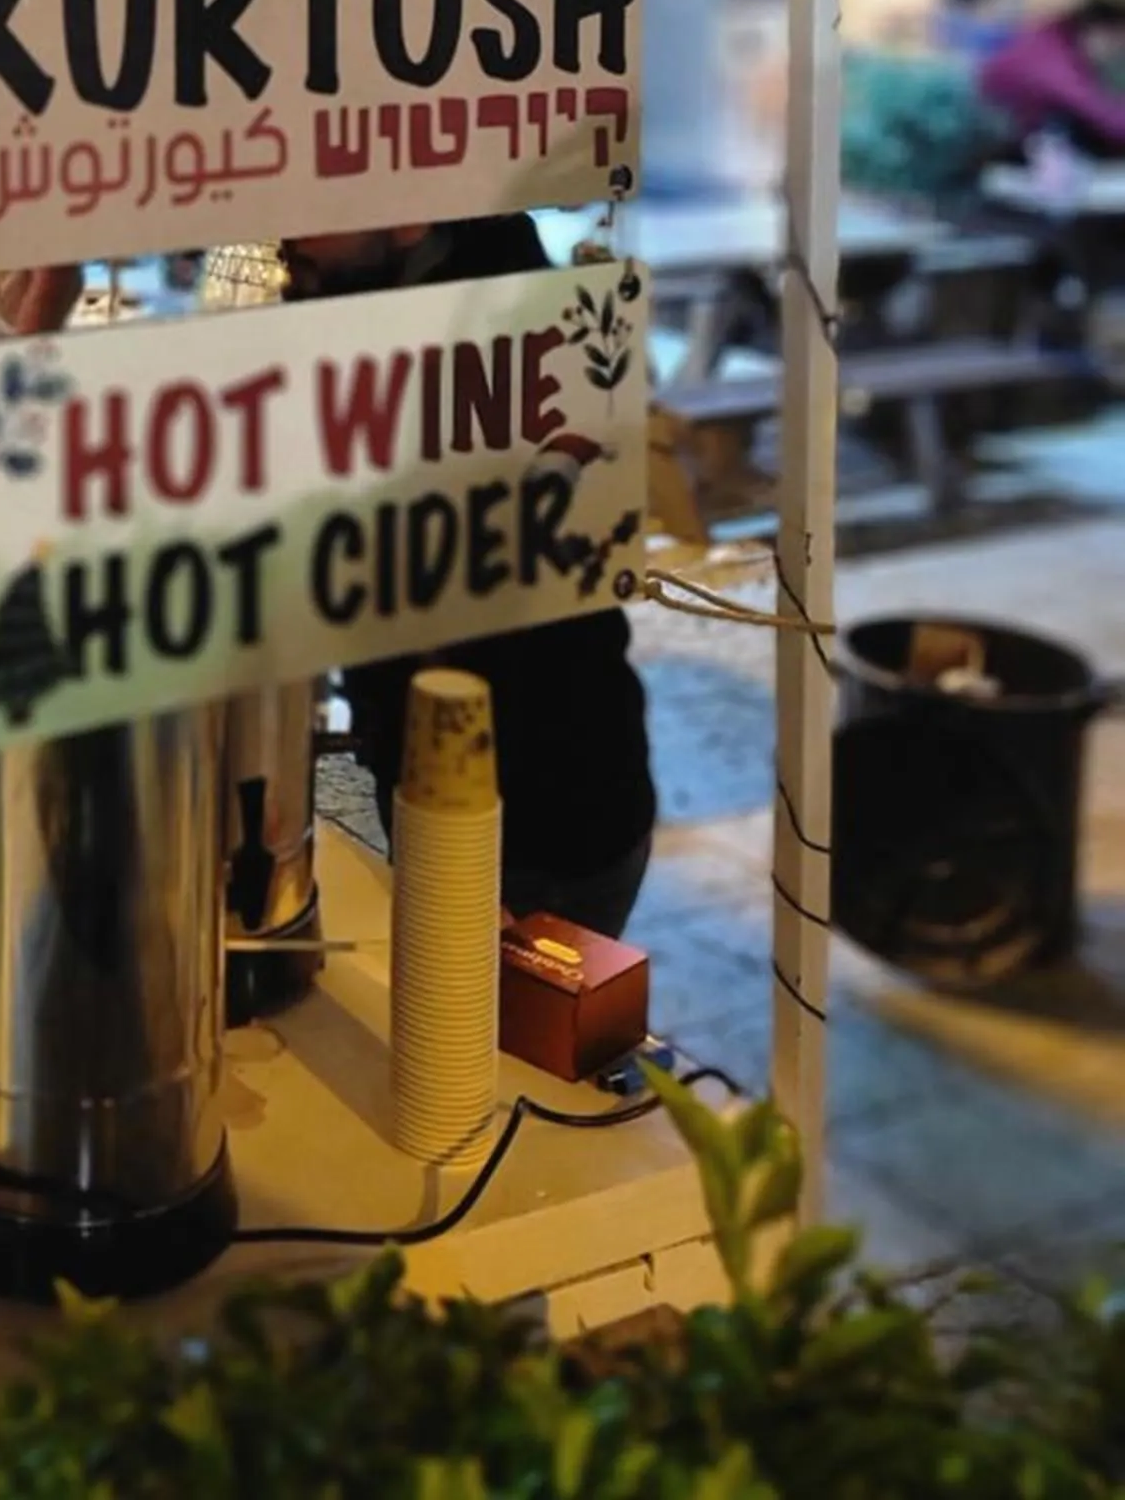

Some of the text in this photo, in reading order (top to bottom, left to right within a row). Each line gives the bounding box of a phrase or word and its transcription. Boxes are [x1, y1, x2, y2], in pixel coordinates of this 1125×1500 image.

[313, 86, 629, 180] קיורטוש
[59, 324, 568, 523] HOT WINE
[61, 471, 577, 680] HOT CIDER
